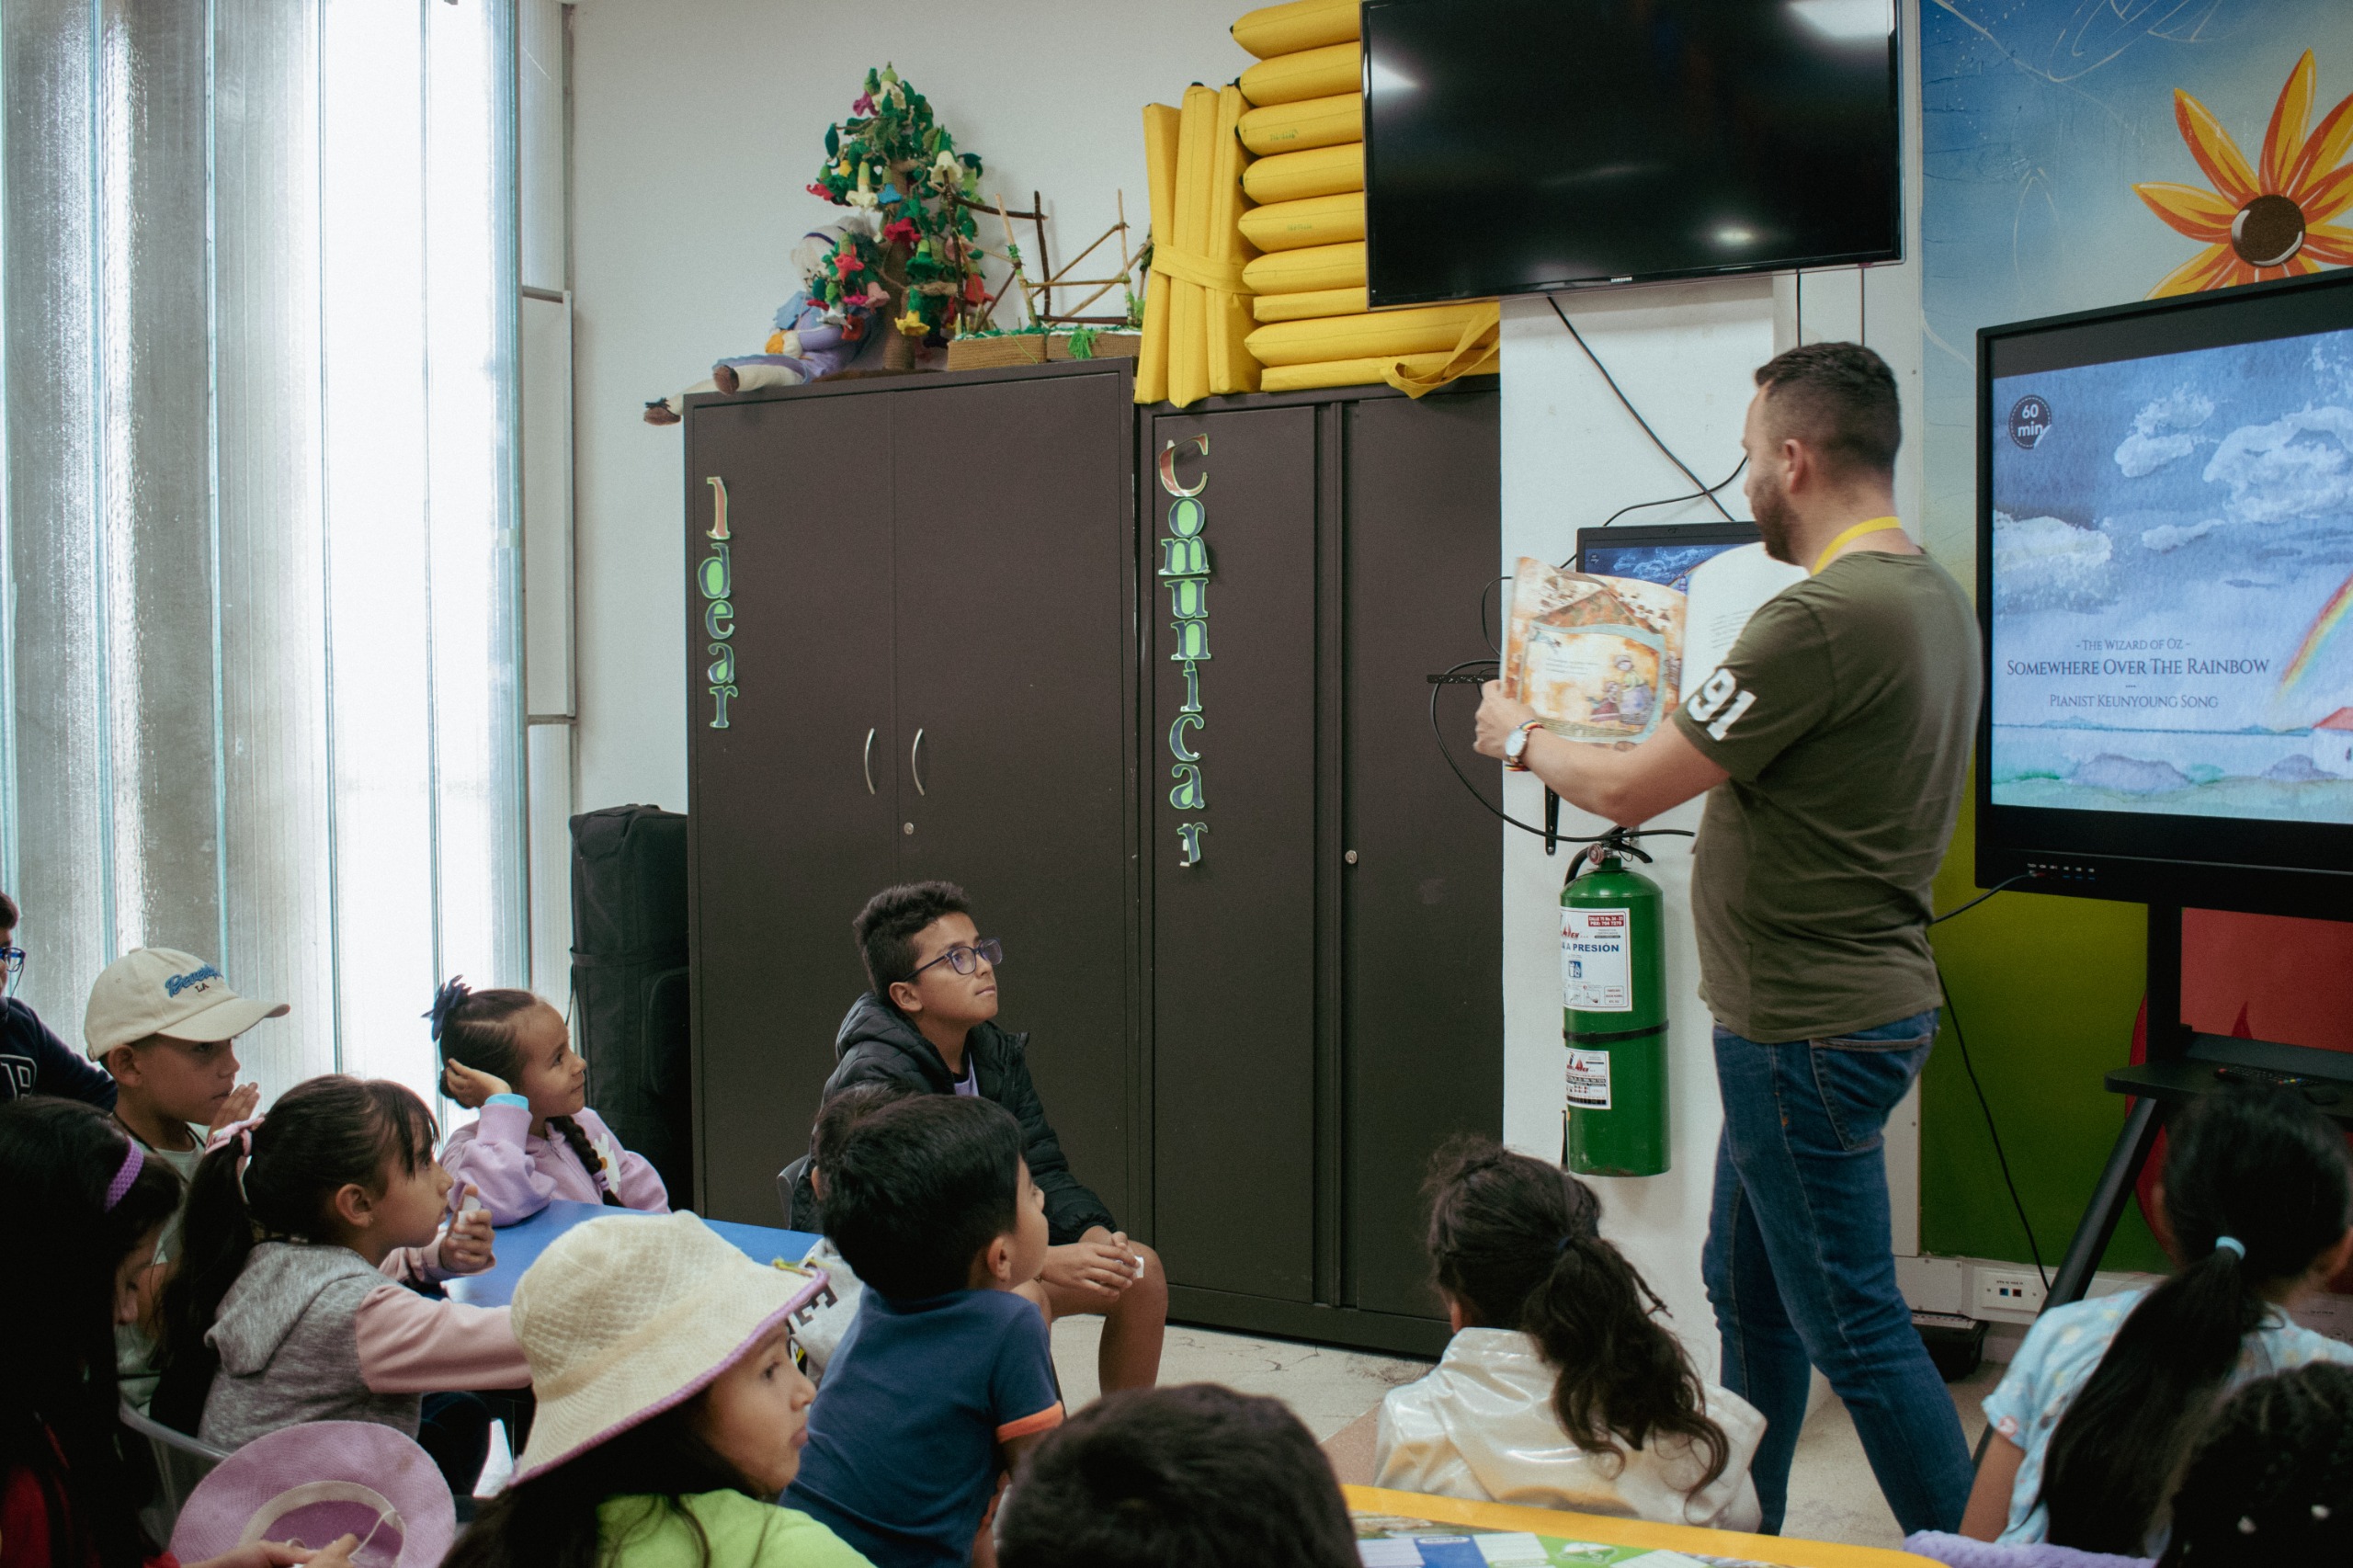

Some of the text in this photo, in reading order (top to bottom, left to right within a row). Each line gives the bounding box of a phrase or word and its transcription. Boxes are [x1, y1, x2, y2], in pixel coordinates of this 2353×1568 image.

[2022, 403, 2039, 419] 60
[2018, 421, 2043, 437] min
[1159, 433, 1210, 867] Comunicar
[2082, 640, 2102, 651] THE
[2105, 639, 2147, 651] WIZARD
[2166, 638, 2184, 650] OZ
[2006, 658, 2269, 676] SOMEWHERE OVER THE RAINBOW
[1688, 668, 1757, 741] 91
[2050, 694, 2219, 708] PIANIST KEUNYOUNG SONG
[1573, 942, 1620, 953] PRESIÓN
[195, 983, 210, 993] LA
